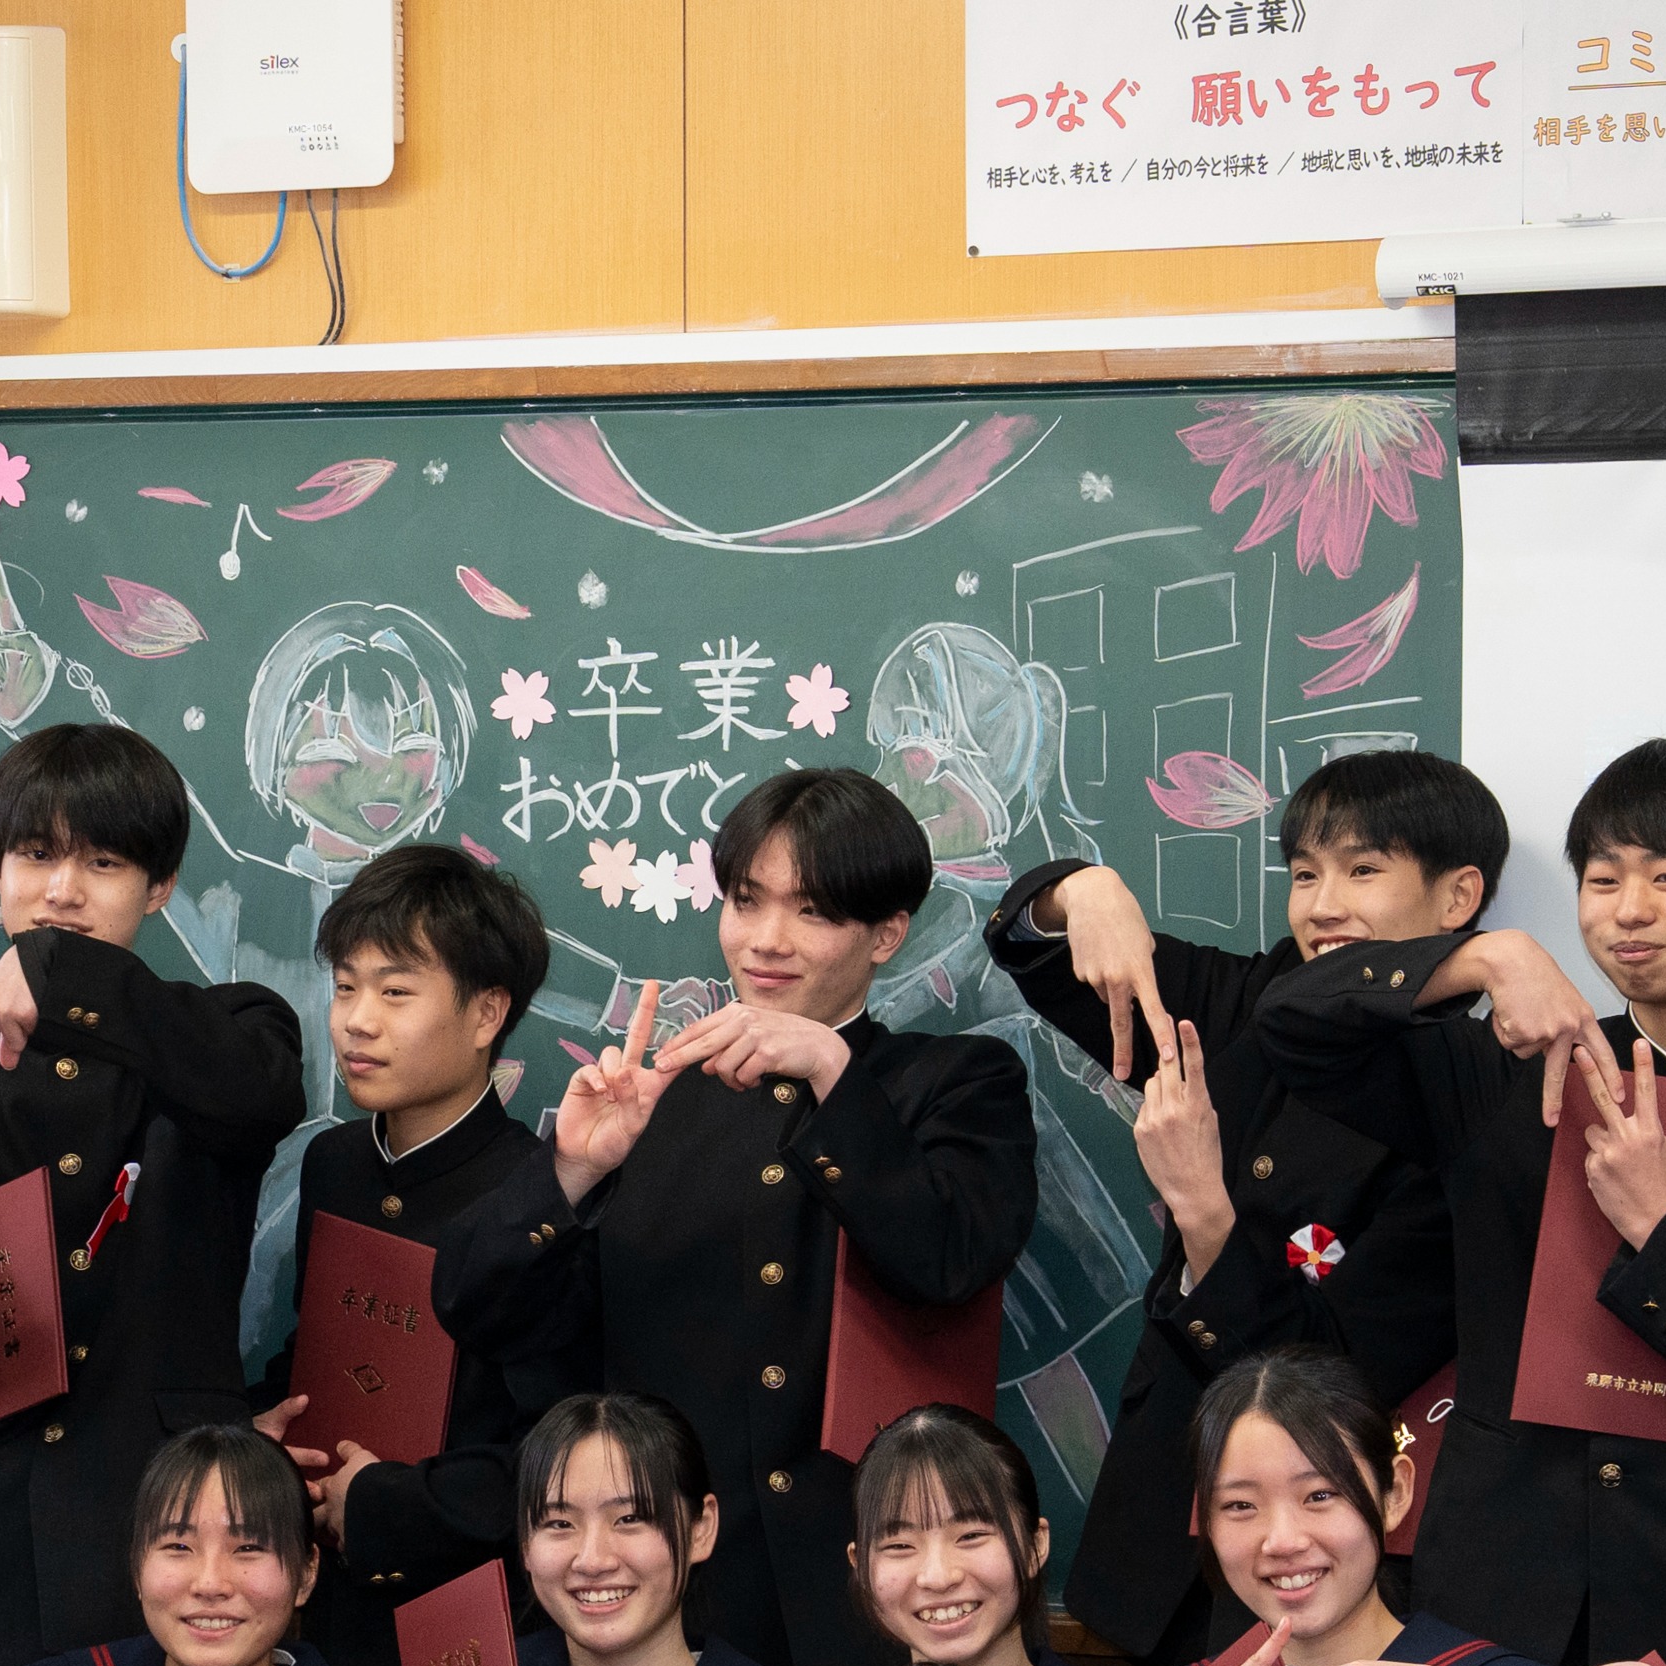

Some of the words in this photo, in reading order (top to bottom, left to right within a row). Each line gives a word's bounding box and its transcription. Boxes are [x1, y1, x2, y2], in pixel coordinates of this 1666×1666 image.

[1174, 0, 1309, 41] 《合言葉》
[259, 54, 300, 70] silex
[994, 78, 1142, 133] つなぐ
[1191, 60, 1498, 128] 願いをもって
[287, 123, 334, 134] KMC-1054
[986, 158, 1114, 190] 相手と心を、考えを
[1144, 151, 1270, 182] 自分の今と将来を
[1300, 140, 1505, 176] 地域と思いを、地域の未来を
[1417, 272, 1465, 282] KMC-1021
[567, 638, 788, 756] 卒業
[498, 754, 805, 843] おめでと
[337, 1286, 421, 1335] 卒業証書
